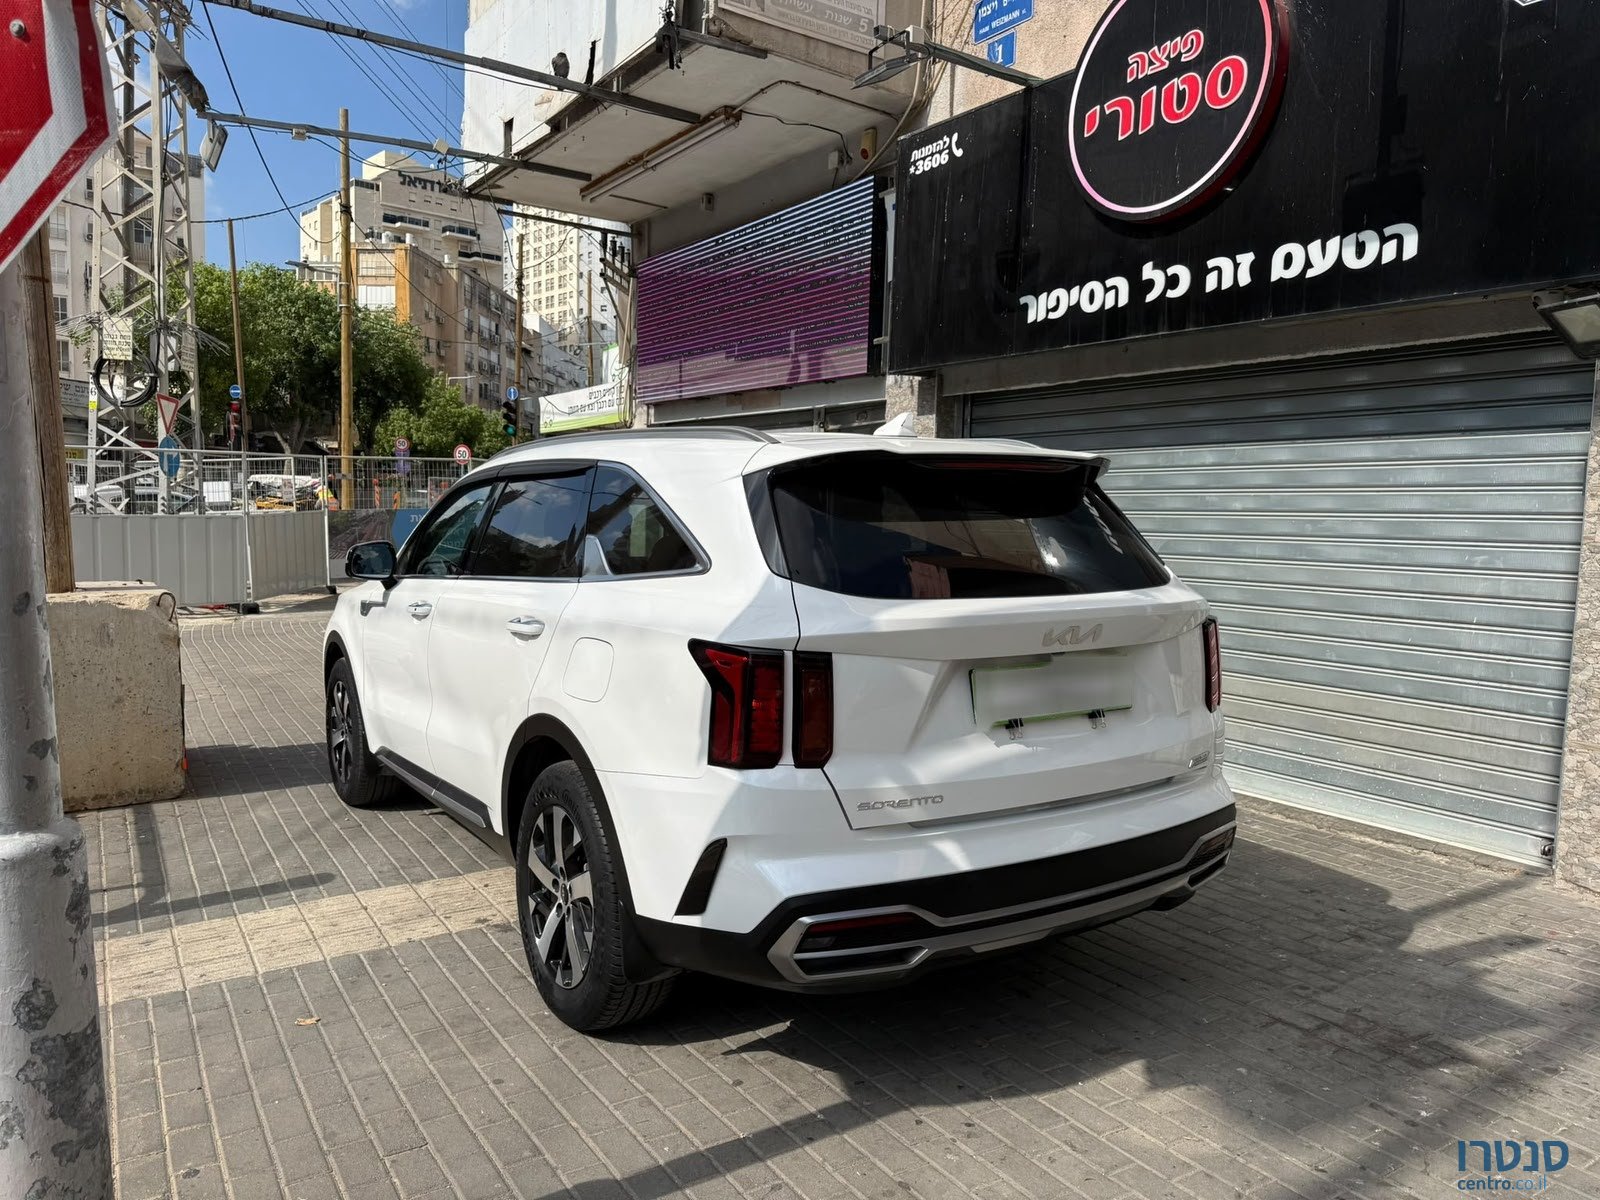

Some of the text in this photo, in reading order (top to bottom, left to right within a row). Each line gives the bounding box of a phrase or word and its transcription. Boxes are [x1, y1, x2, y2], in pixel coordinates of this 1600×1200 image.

[824, 9, 852, 26] שנות
[858, 18, 869, 33] 5
[1127, 28, 1205, 84] פיצה
[1083, 55, 1248, 141] סטורי
[910, 133, 951, 162] להזמנות
[1019, 222, 1419, 325] הטעם זה כל הסיפור
[457, 449, 467, 459] 50
[856, 794, 945, 812] SORENTO
